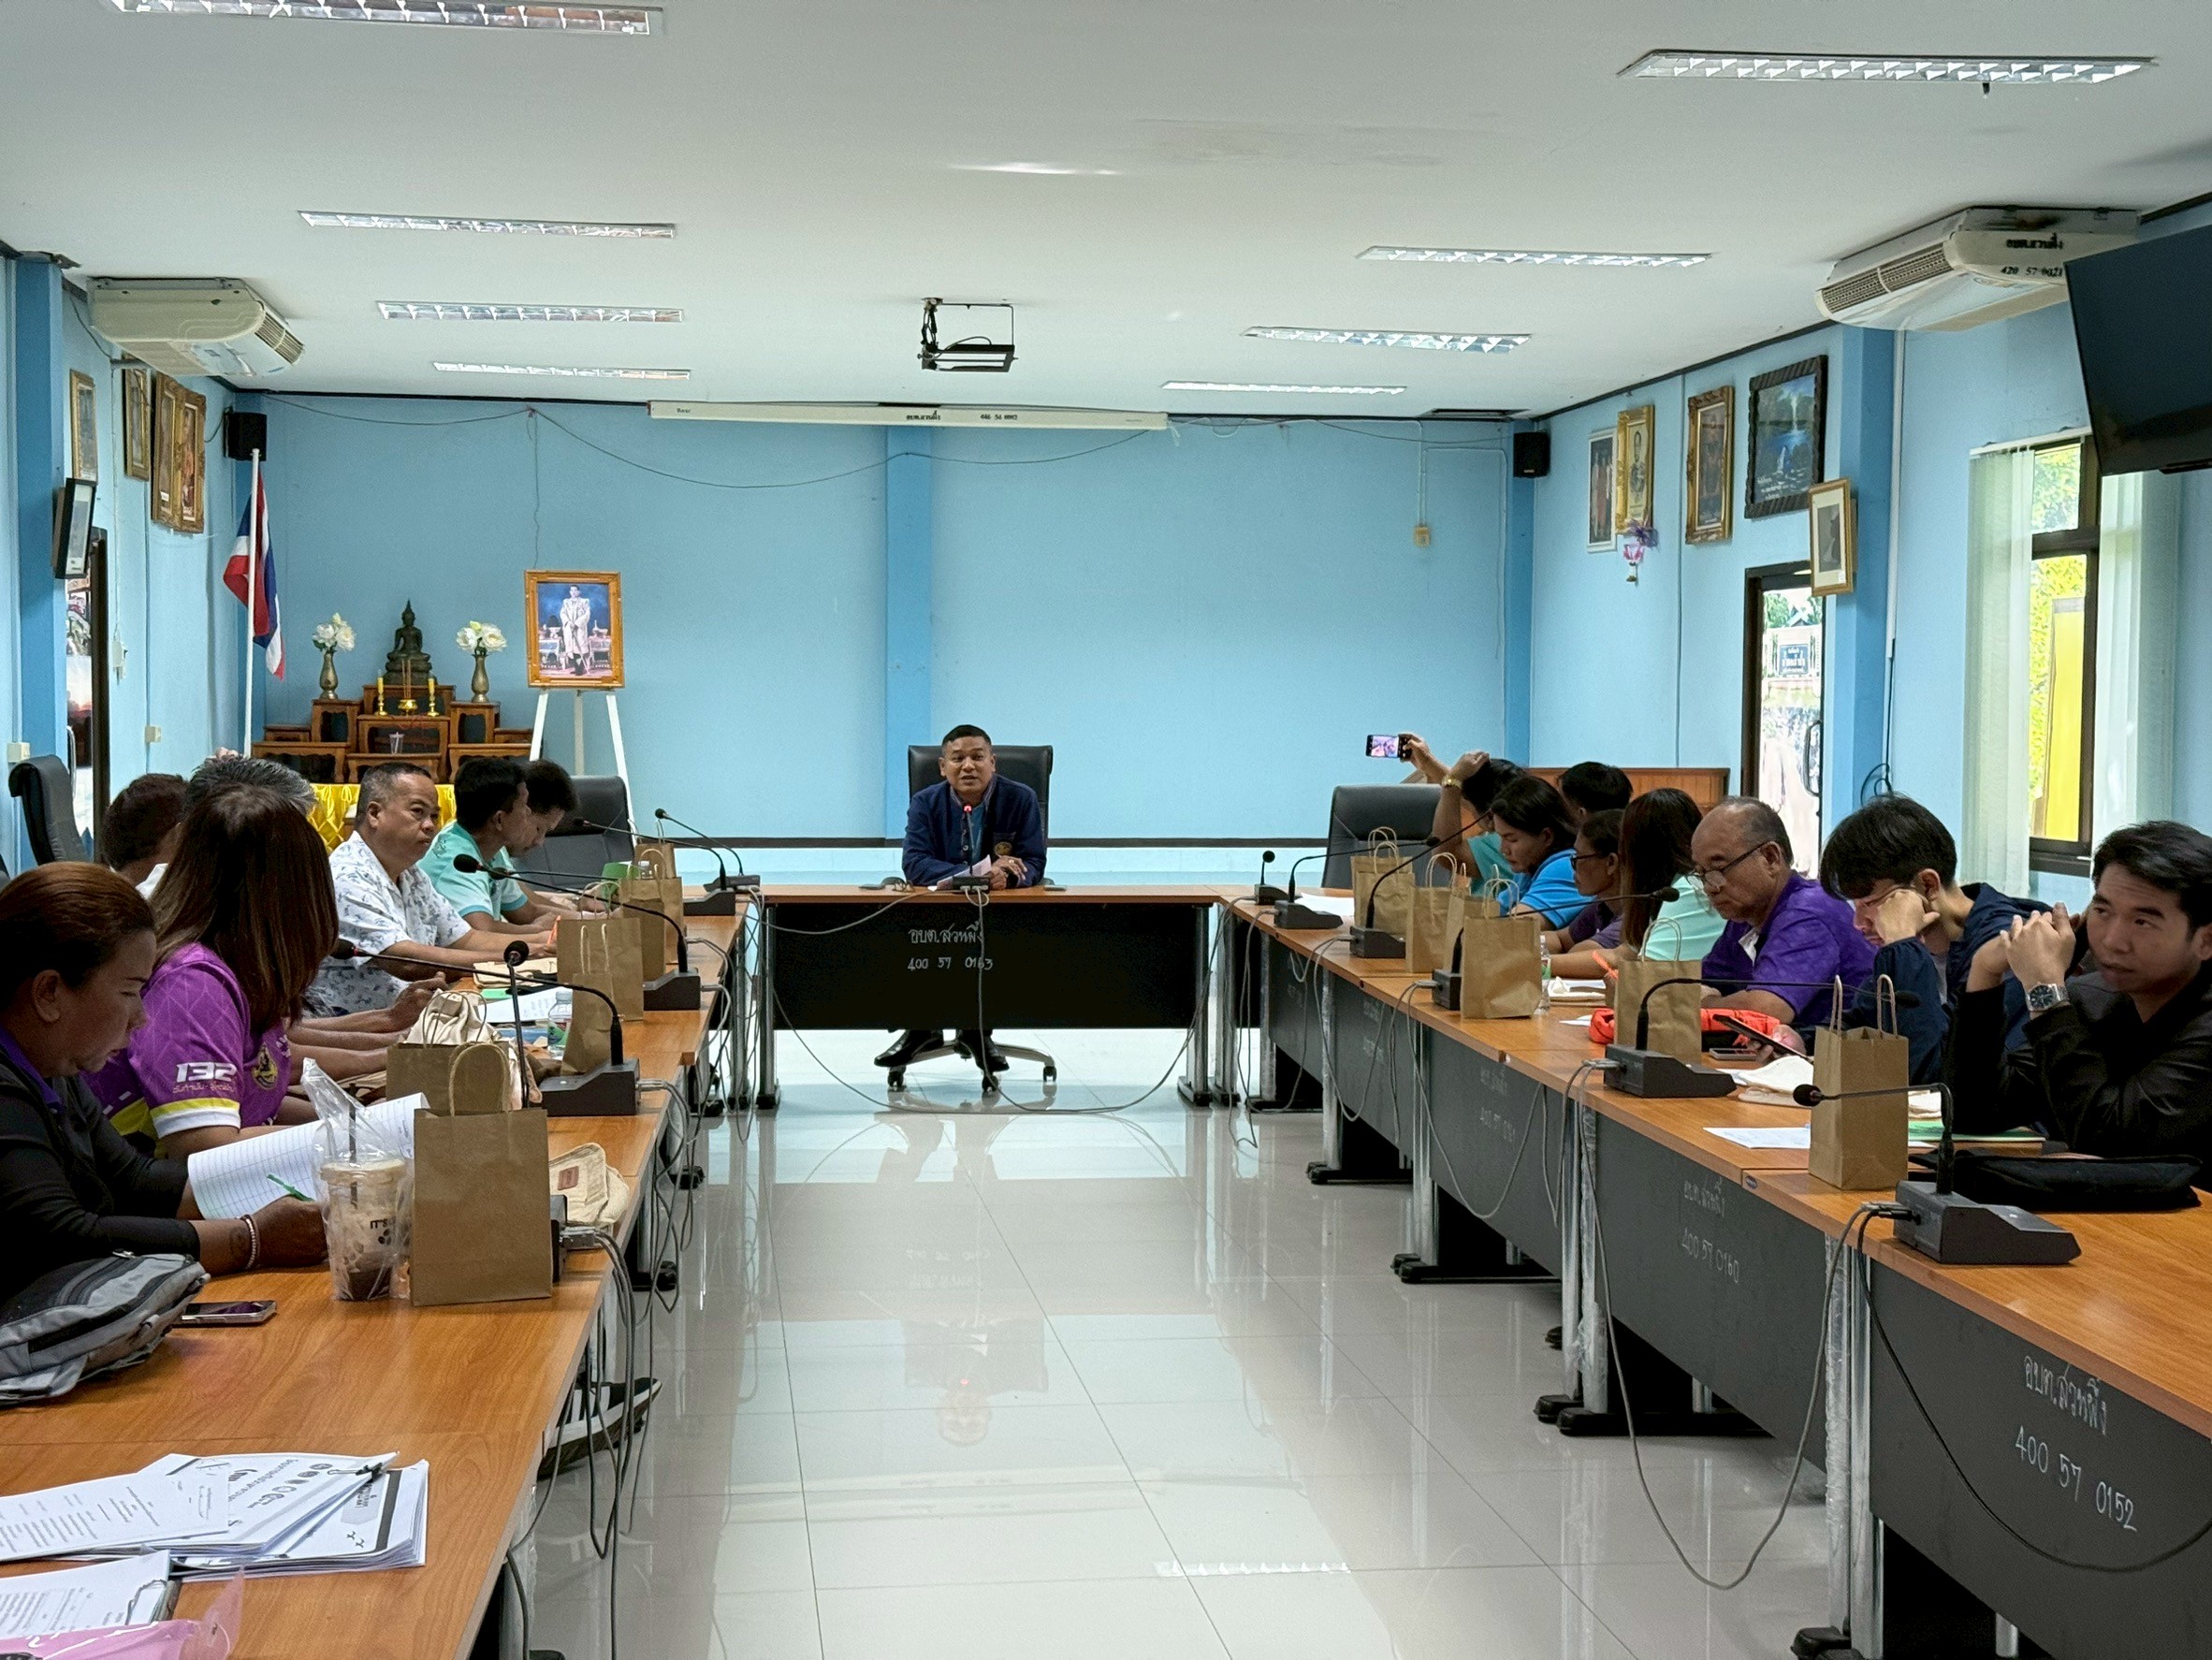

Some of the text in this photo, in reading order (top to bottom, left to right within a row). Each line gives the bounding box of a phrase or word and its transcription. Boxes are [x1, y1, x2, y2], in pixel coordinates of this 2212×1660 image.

[908, 956, 929, 971] 400
[938, 956, 952, 969] 57
[176, 1061, 238, 1083] 132
[2015, 1425, 2138, 1533] 400 57 0152
